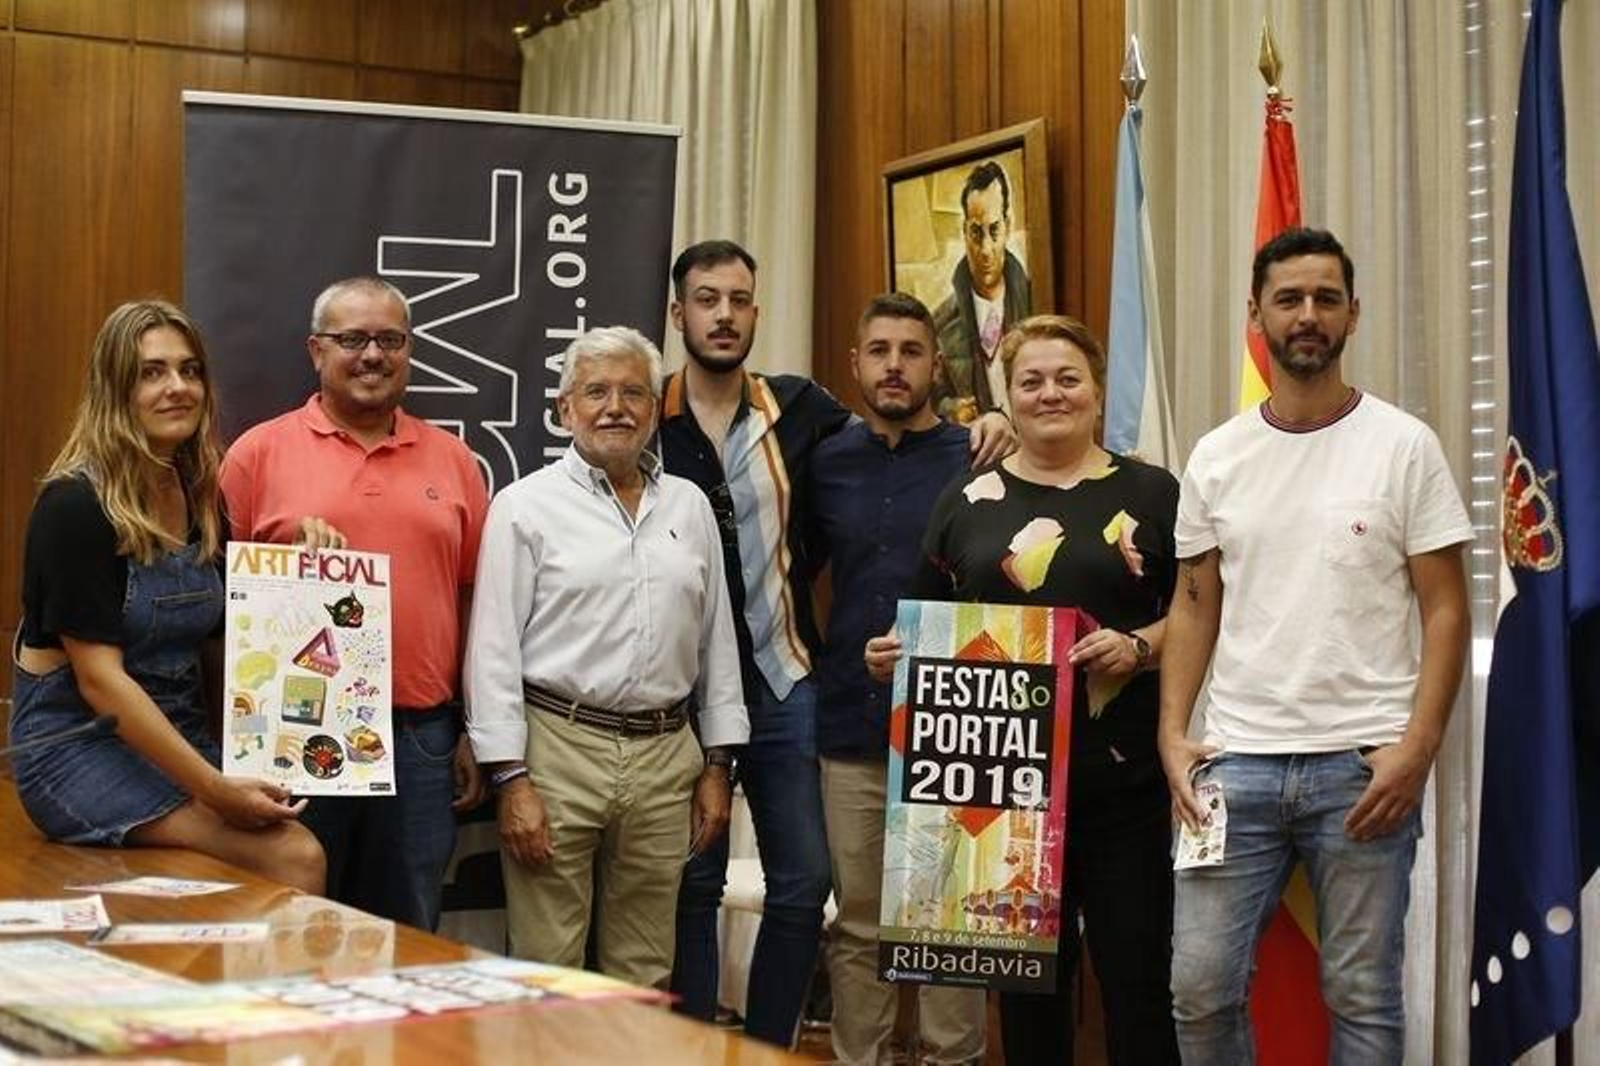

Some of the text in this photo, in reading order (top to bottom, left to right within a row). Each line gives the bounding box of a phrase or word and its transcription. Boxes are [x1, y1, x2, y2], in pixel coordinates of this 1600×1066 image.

[912, 710, 1047, 760] PORTAL
[909, 759, 1045, 807] 2019
[892, 946, 1042, 978] Ribadavia
